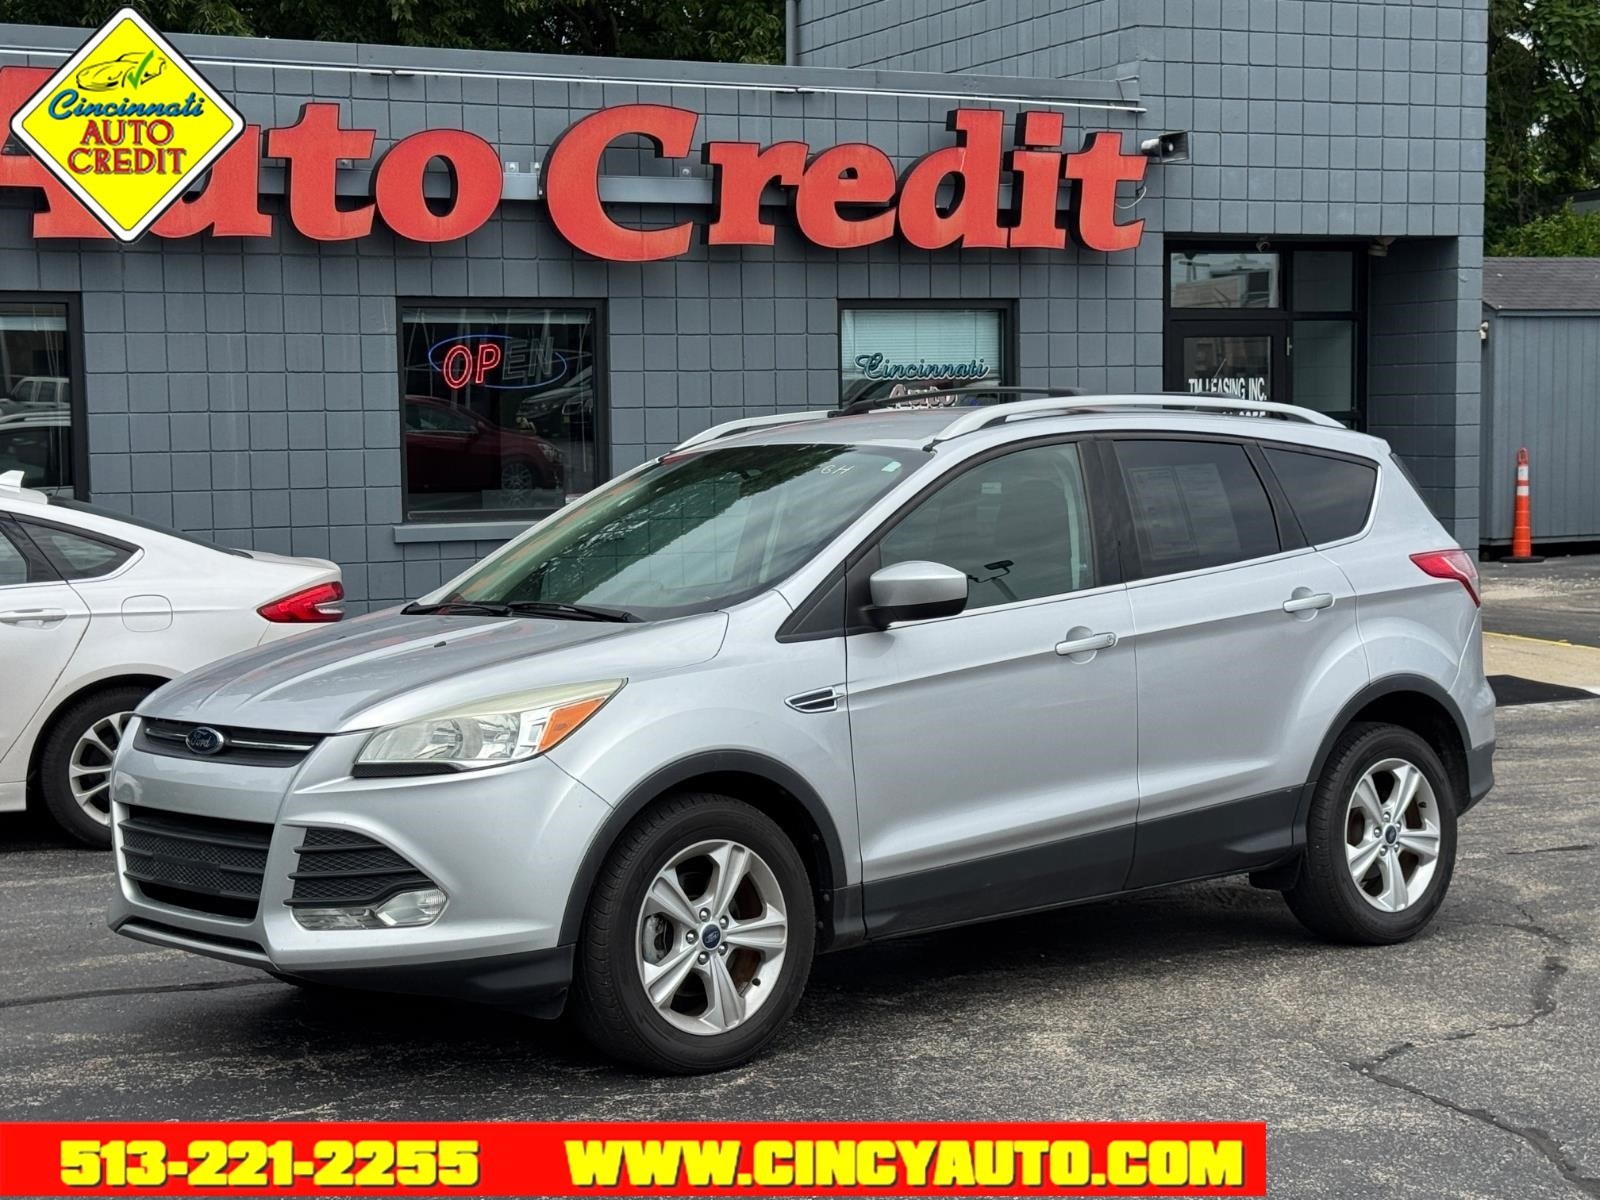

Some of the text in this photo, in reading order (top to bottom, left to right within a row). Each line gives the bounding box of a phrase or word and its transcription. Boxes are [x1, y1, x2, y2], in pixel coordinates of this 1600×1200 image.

[543, 104, 1149, 262] Credit
[443, 336, 555, 390] OPEN
[855, 352, 989, 380] Cincinnati
